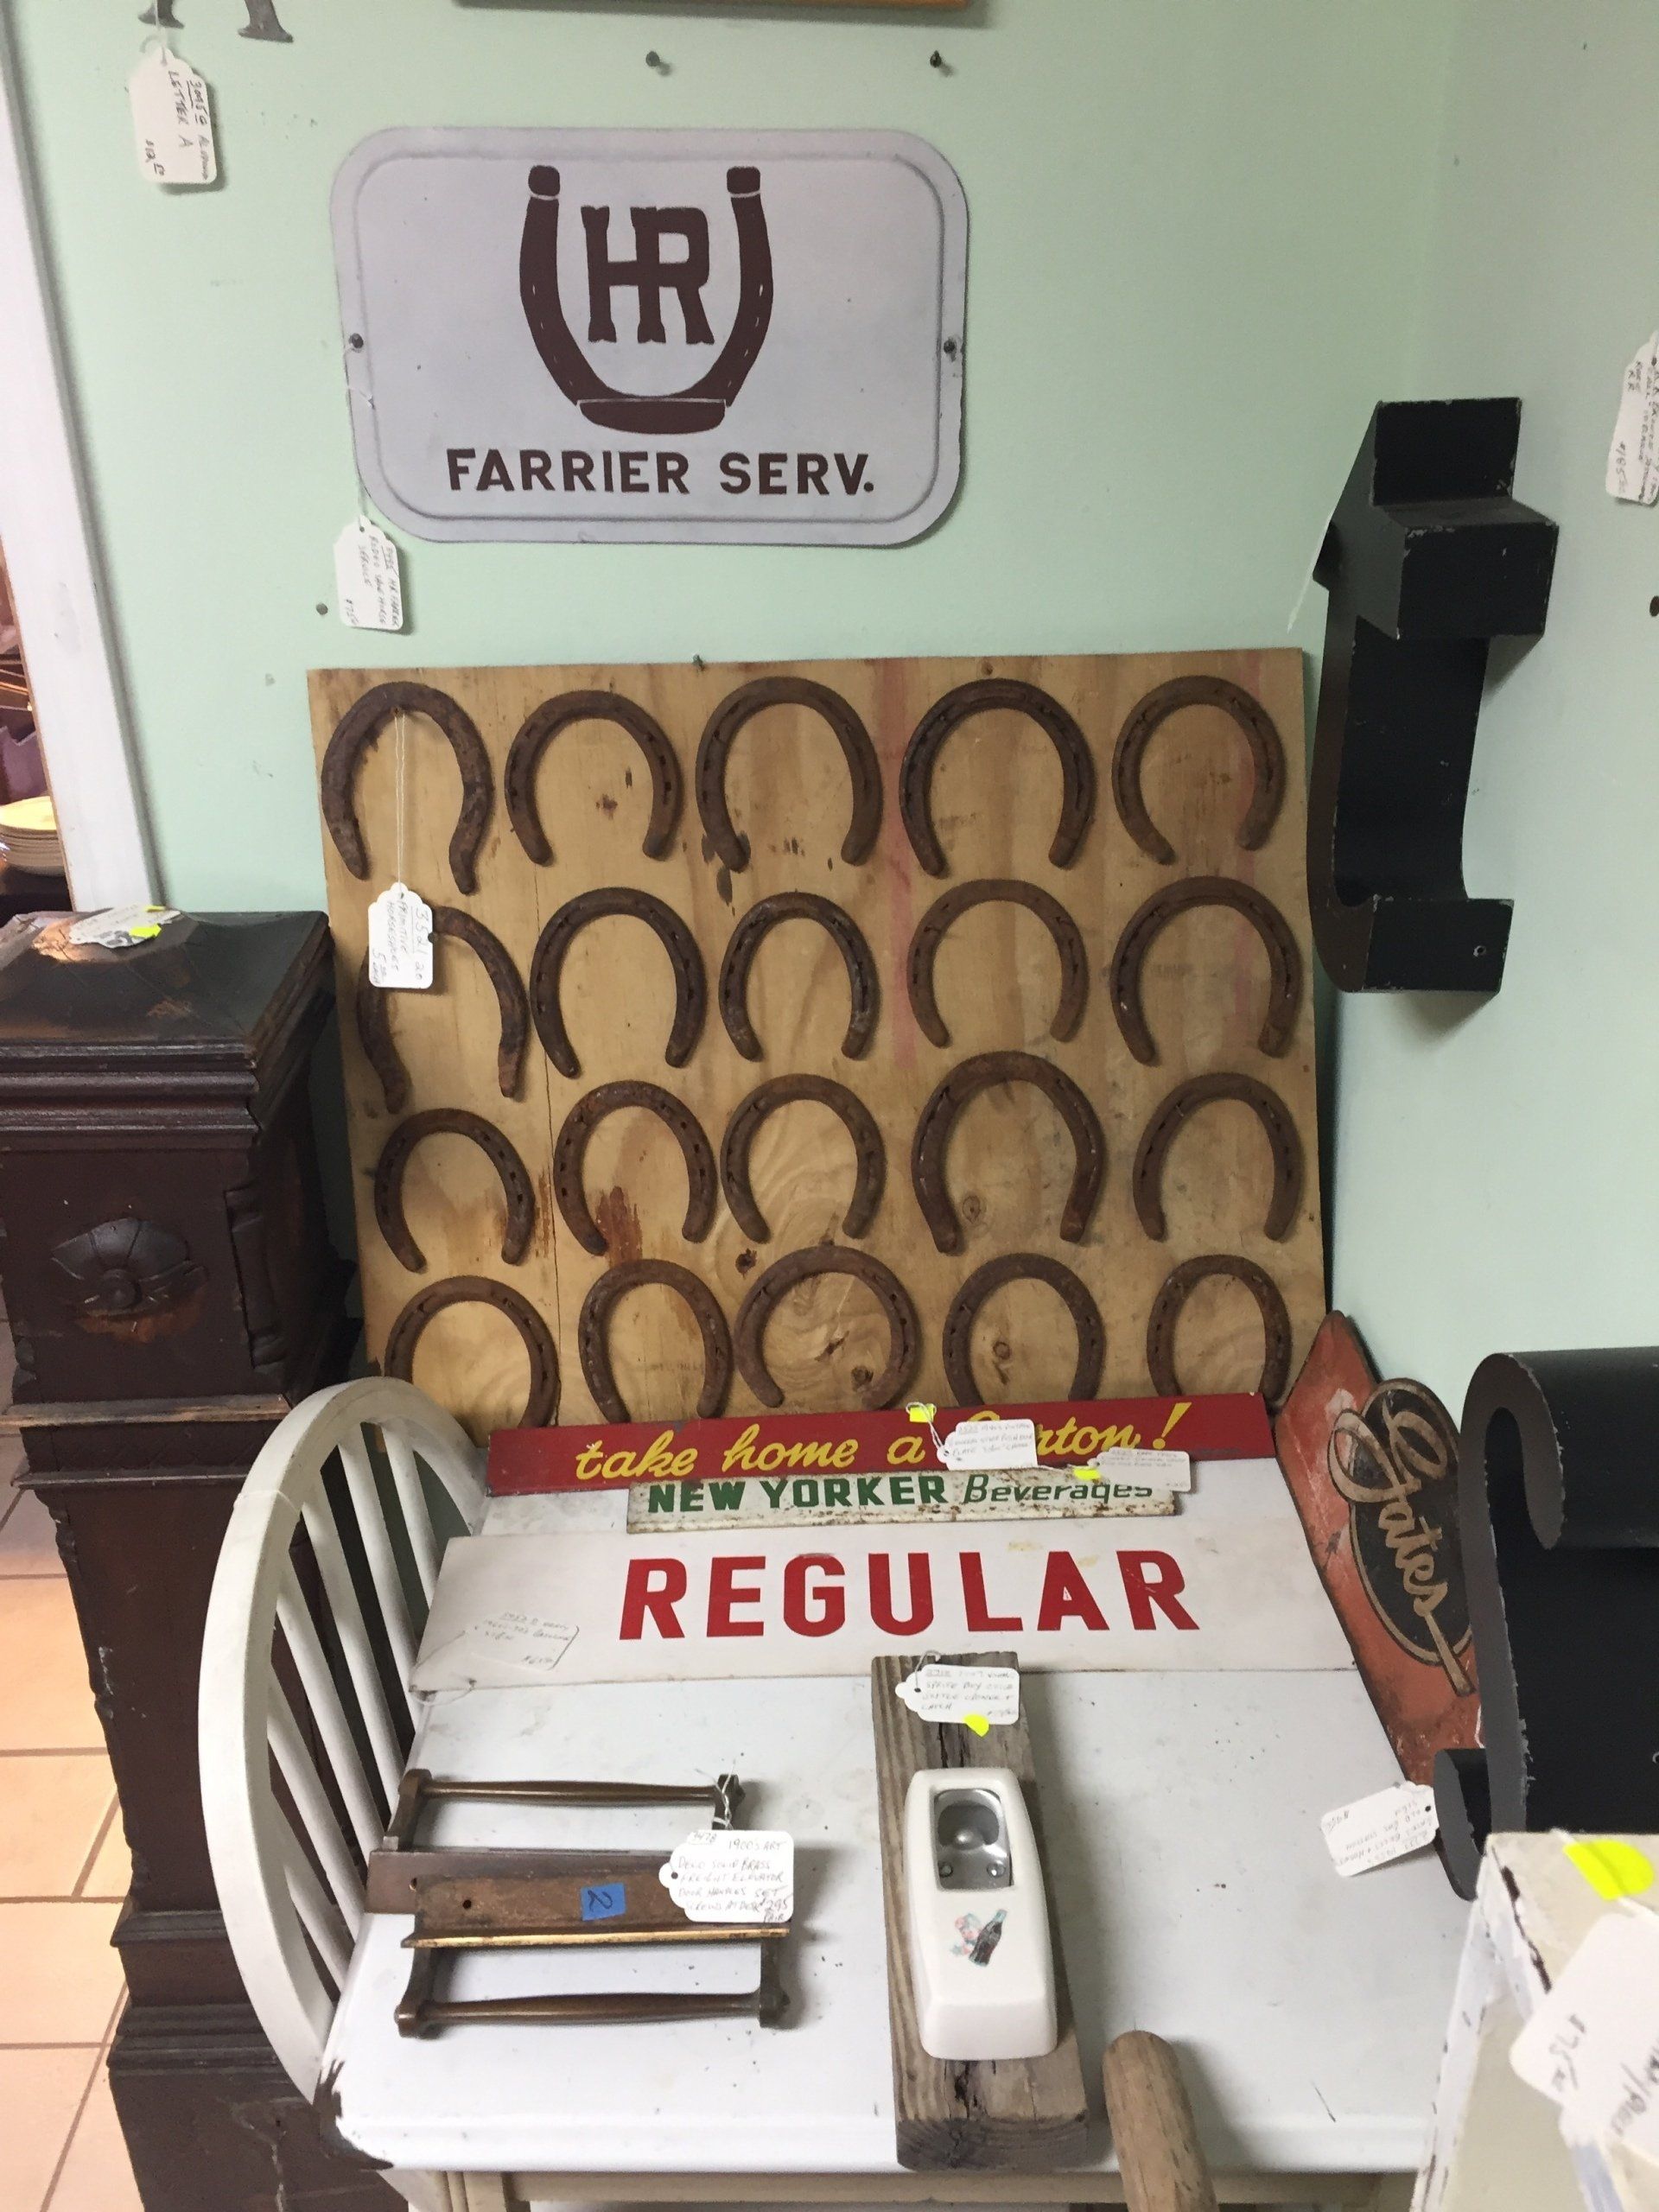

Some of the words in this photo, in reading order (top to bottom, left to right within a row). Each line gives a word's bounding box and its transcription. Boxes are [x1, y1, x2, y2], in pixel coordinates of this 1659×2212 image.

[581, 205, 715, 344] HR
[446, 448, 690, 493] FARRIER
[718, 452, 875, 495] SERV.
[575, 1429, 698, 1480] take
[721, 1423, 858, 1472] home
[887, 1436, 925, 1465] a
[967, 1402, 1192, 1456] rton!
[648, 1480, 746, 1513] NEW
[760, 1475, 949, 1509] YORKER
[619, 1549, 1200, 1641] REGULAR
